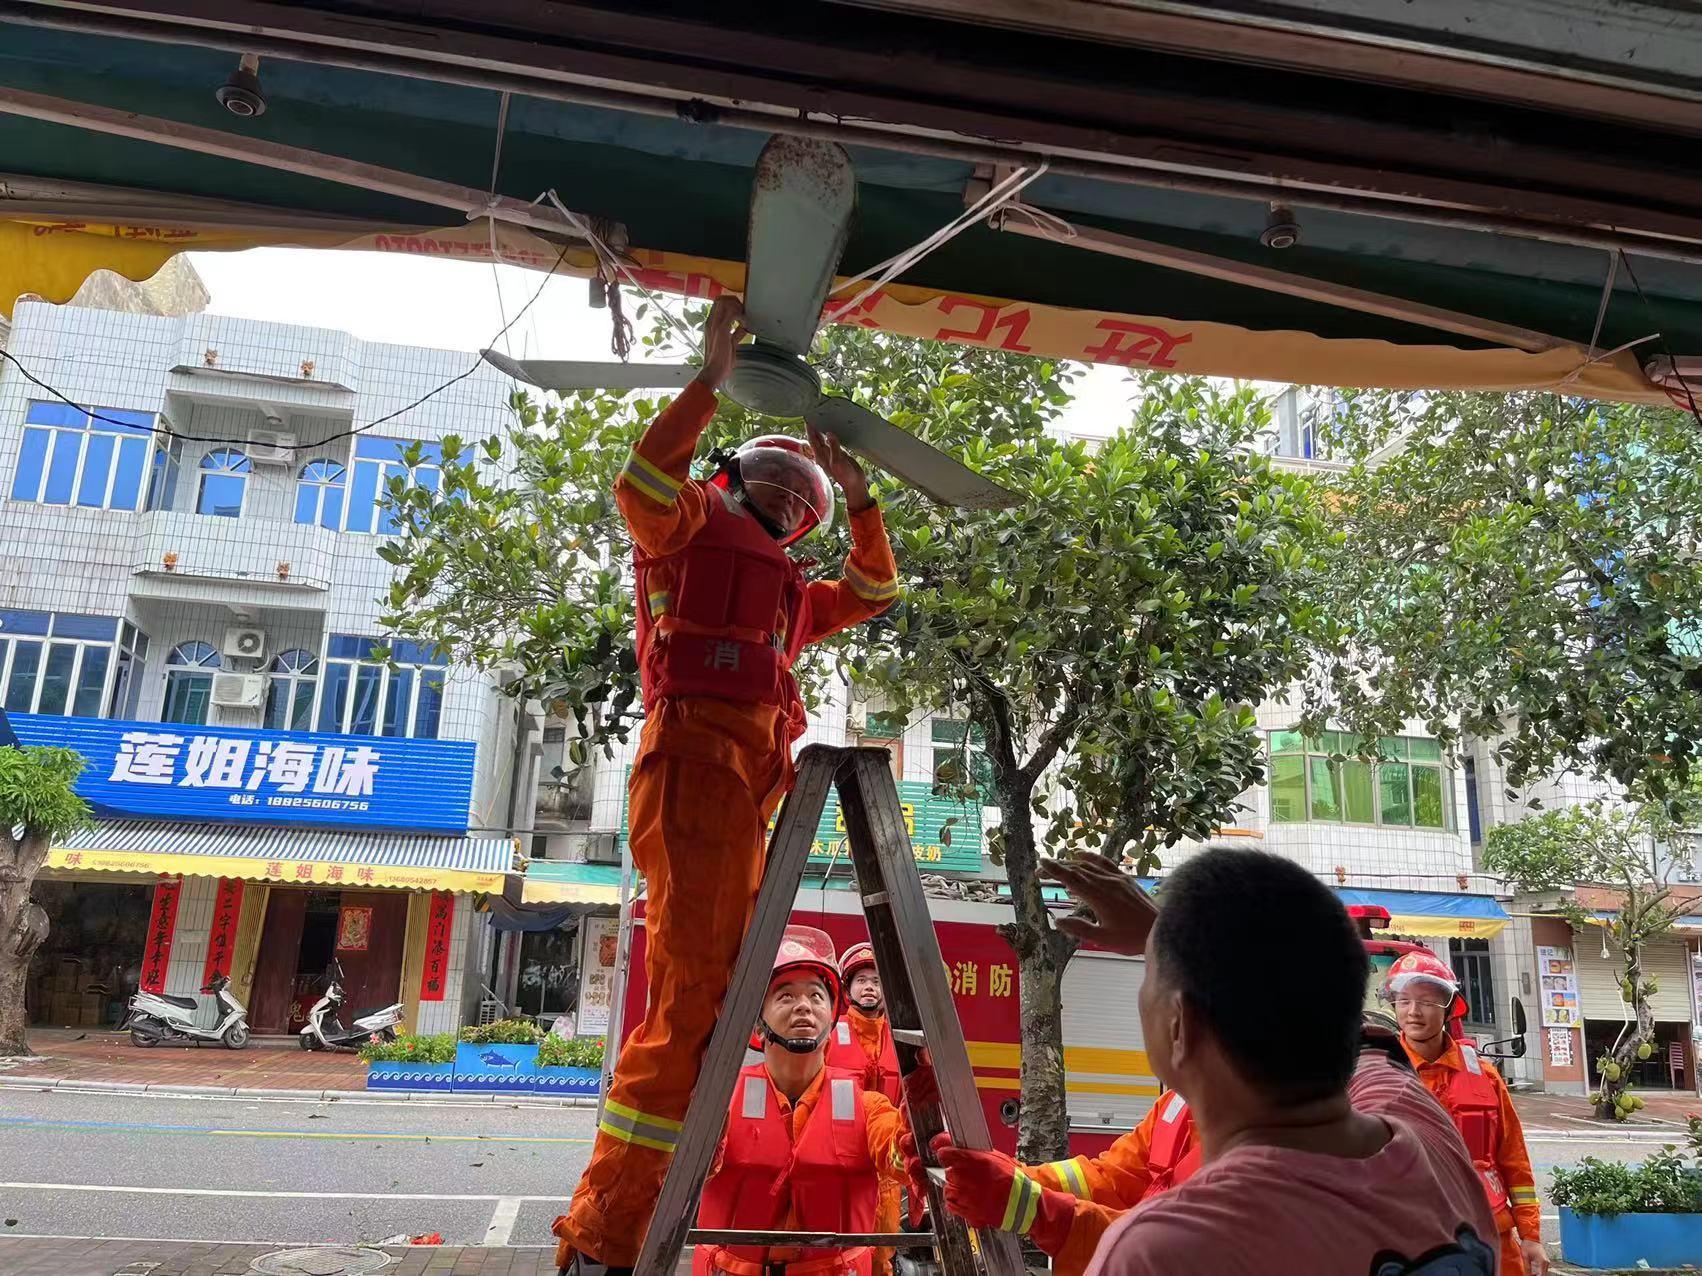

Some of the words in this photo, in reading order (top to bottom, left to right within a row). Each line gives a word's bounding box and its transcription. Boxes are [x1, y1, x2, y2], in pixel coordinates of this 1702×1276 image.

[704, 640, 740, 672] 消
[108, 731, 381, 796] 莲姐海味
[264, 862, 374, 882] 莲姐海味
[953, 961, 1013, 997] 消防
